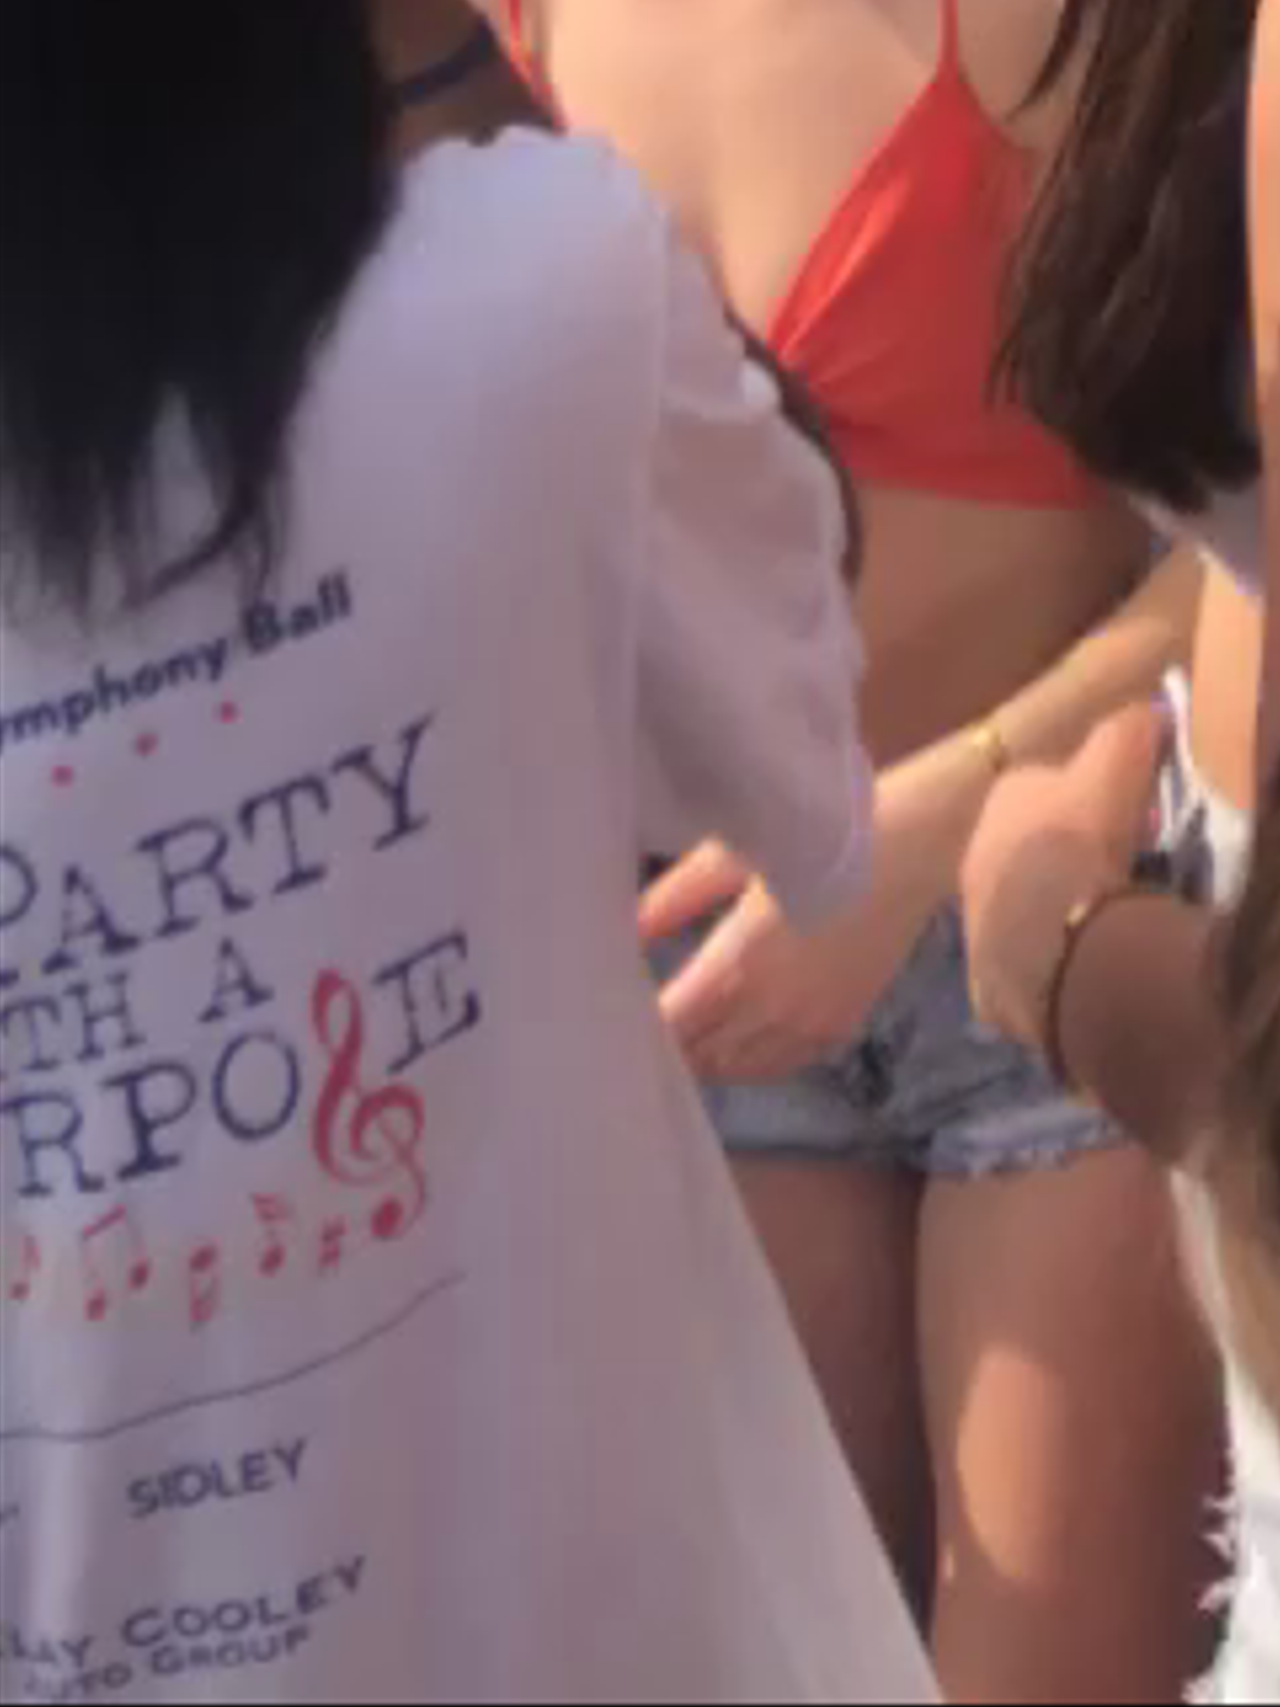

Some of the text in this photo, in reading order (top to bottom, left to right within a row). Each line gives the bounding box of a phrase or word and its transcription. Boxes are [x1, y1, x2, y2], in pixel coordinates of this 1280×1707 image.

[243, 569, 354, 655] Ball
[196, 935, 277, 1025] A
[126, 1433, 310, 1521] SIDLEY
[120, 1555, 367, 1649] COOLEY
[150, 1626, 312, 1677] GROUP
